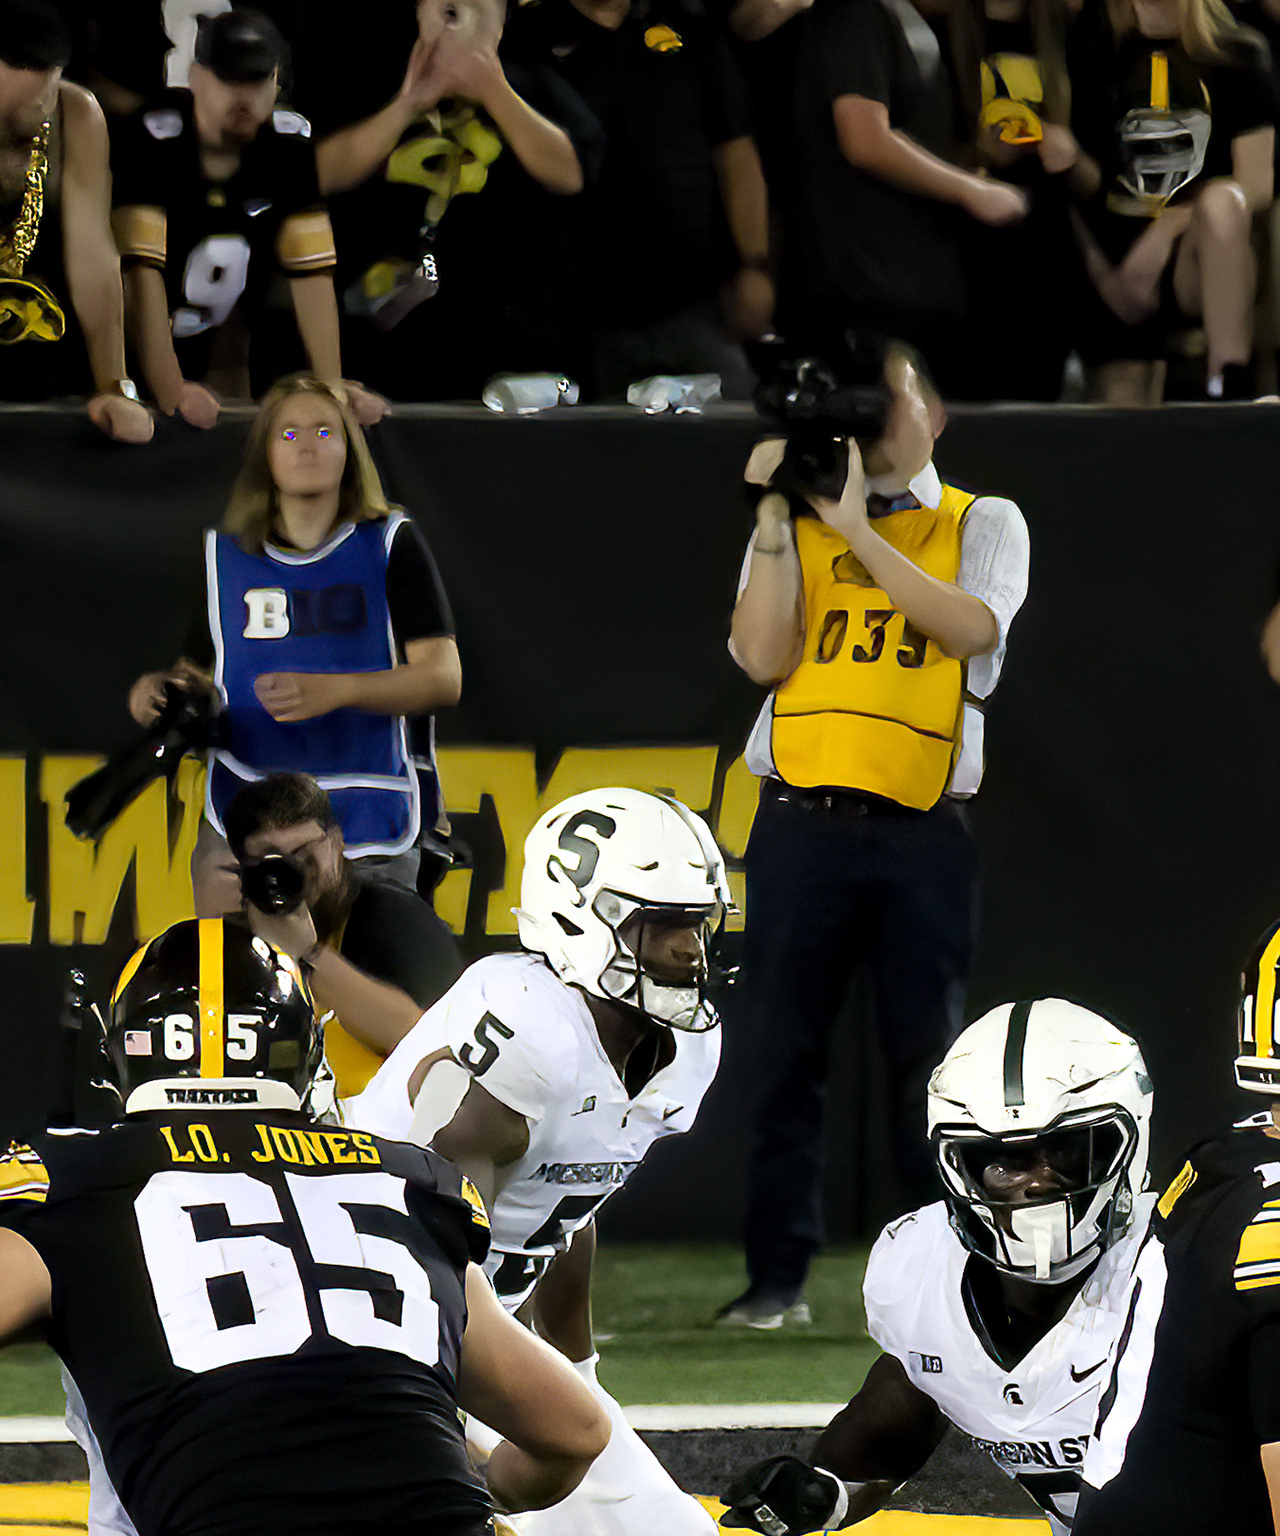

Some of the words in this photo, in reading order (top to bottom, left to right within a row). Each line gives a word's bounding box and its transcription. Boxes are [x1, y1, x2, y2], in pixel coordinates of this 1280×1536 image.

[171, 234, 251, 338] 9
[545, 808, 617, 890] S
[163, 1012, 265, 1062] 65
[459, 1009, 516, 1078] 5
[159, 1123, 231, 1164] LO.
[250, 1122, 383, 1167] JONES
[132, 1170, 442, 1374] 65
